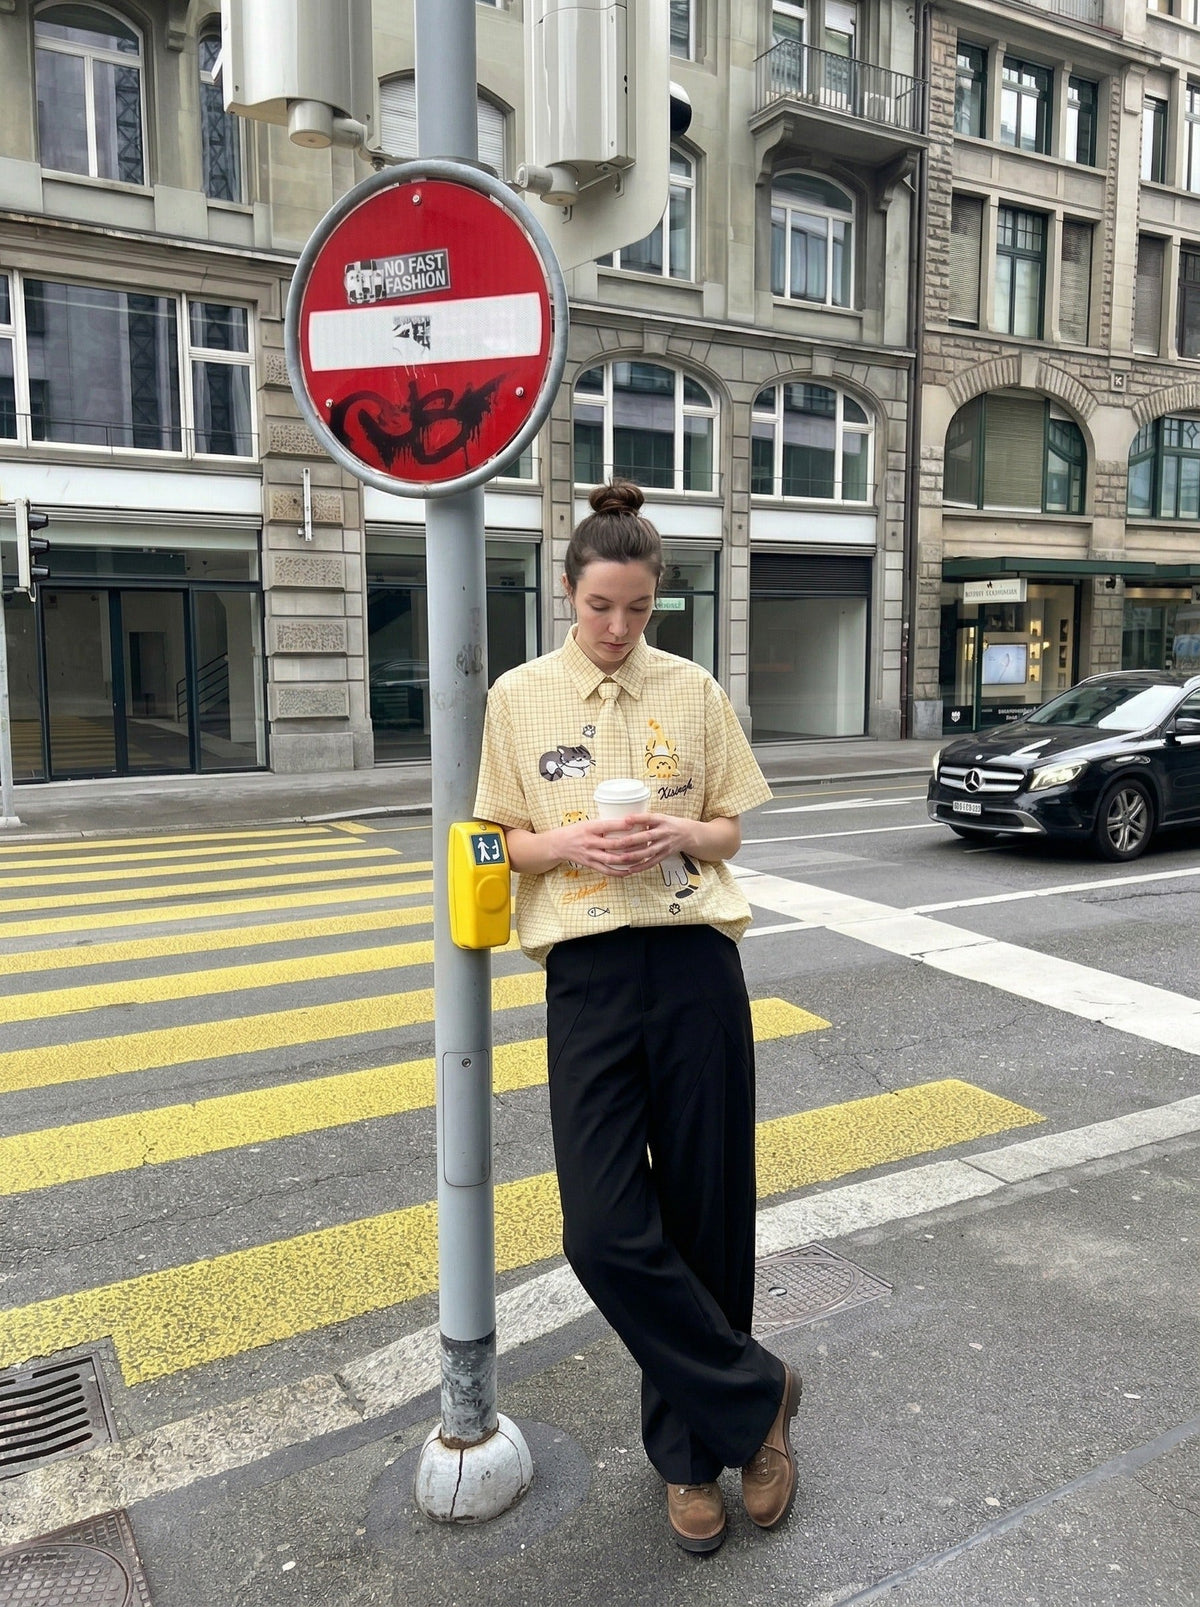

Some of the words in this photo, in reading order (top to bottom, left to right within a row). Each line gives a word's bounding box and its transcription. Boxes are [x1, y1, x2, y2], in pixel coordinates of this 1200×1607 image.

[384, 260, 404, 277] NO
[409, 253, 443, 273] FAST
[385, 270, 446, 294] FASHION
